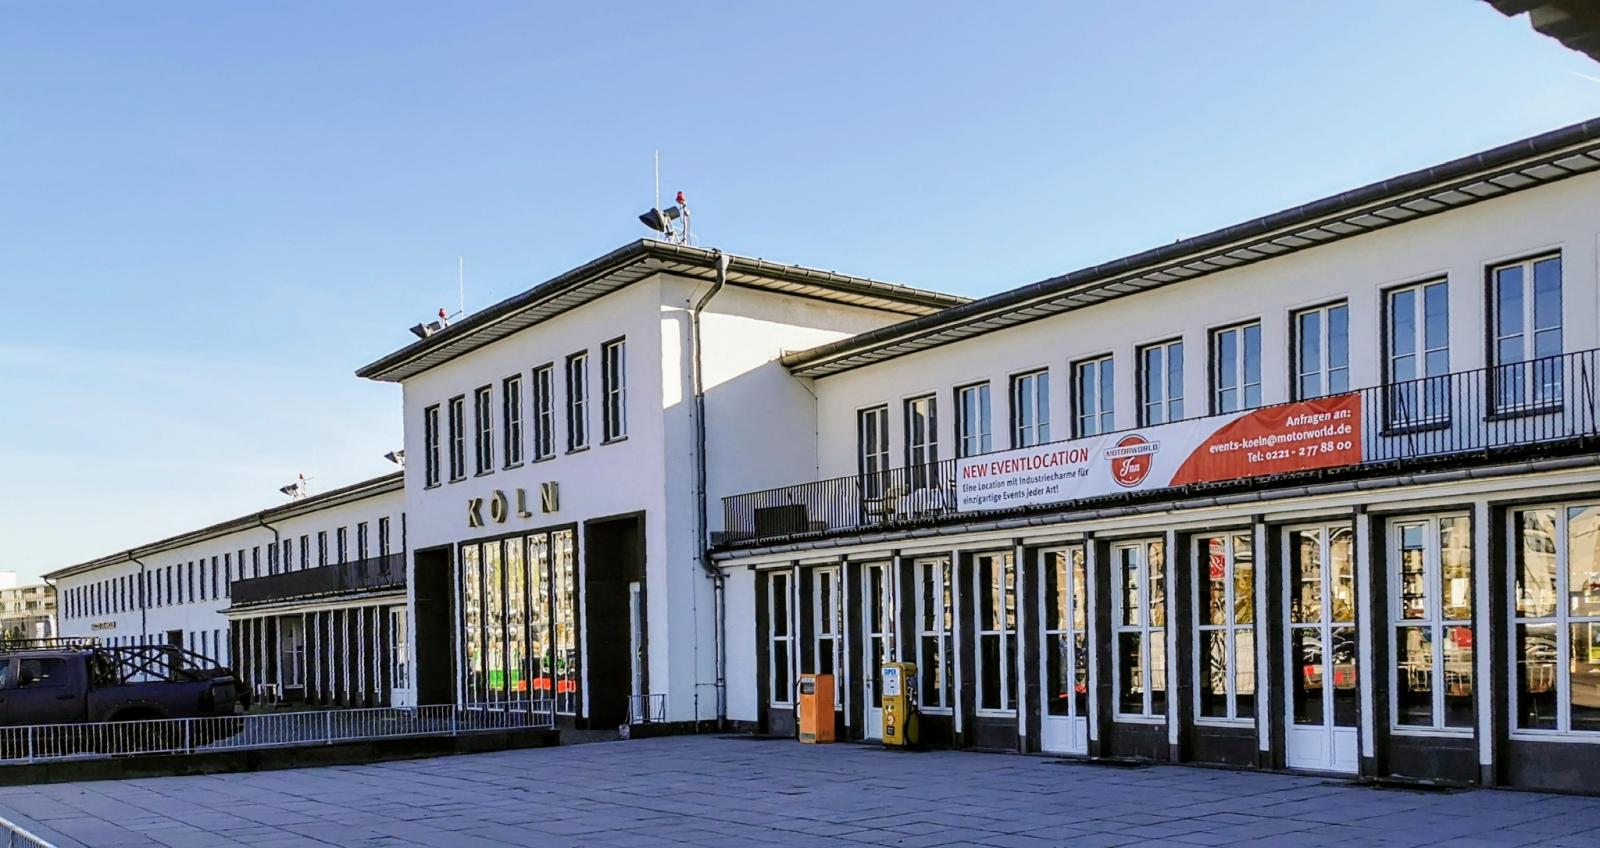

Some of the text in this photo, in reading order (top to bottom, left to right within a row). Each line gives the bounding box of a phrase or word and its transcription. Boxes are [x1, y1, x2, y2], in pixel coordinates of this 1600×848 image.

[1286, 409, 1351, 427] Anfragen an:
[1209, 423, 1352, 453] events-koeln@motorworld.de
[1105, 443, 1158, 457] MOTORWORLD
[1247, 452, 1264, 463] Tel:
[1265, 449, 1290, 460] 0221
[1320, 441, 1334, 453] 88
[963, 448, 1089, 479] NEW EVENTLOCATION
[1119, 456, 1141, 477] Inn
[962, 468, 1089, 492] Eine Location mit Industriecharme für
[468, 480, 560, 528] KÖLN
[963, 484, 1059, 505] einzigartige Events jeder Art!
